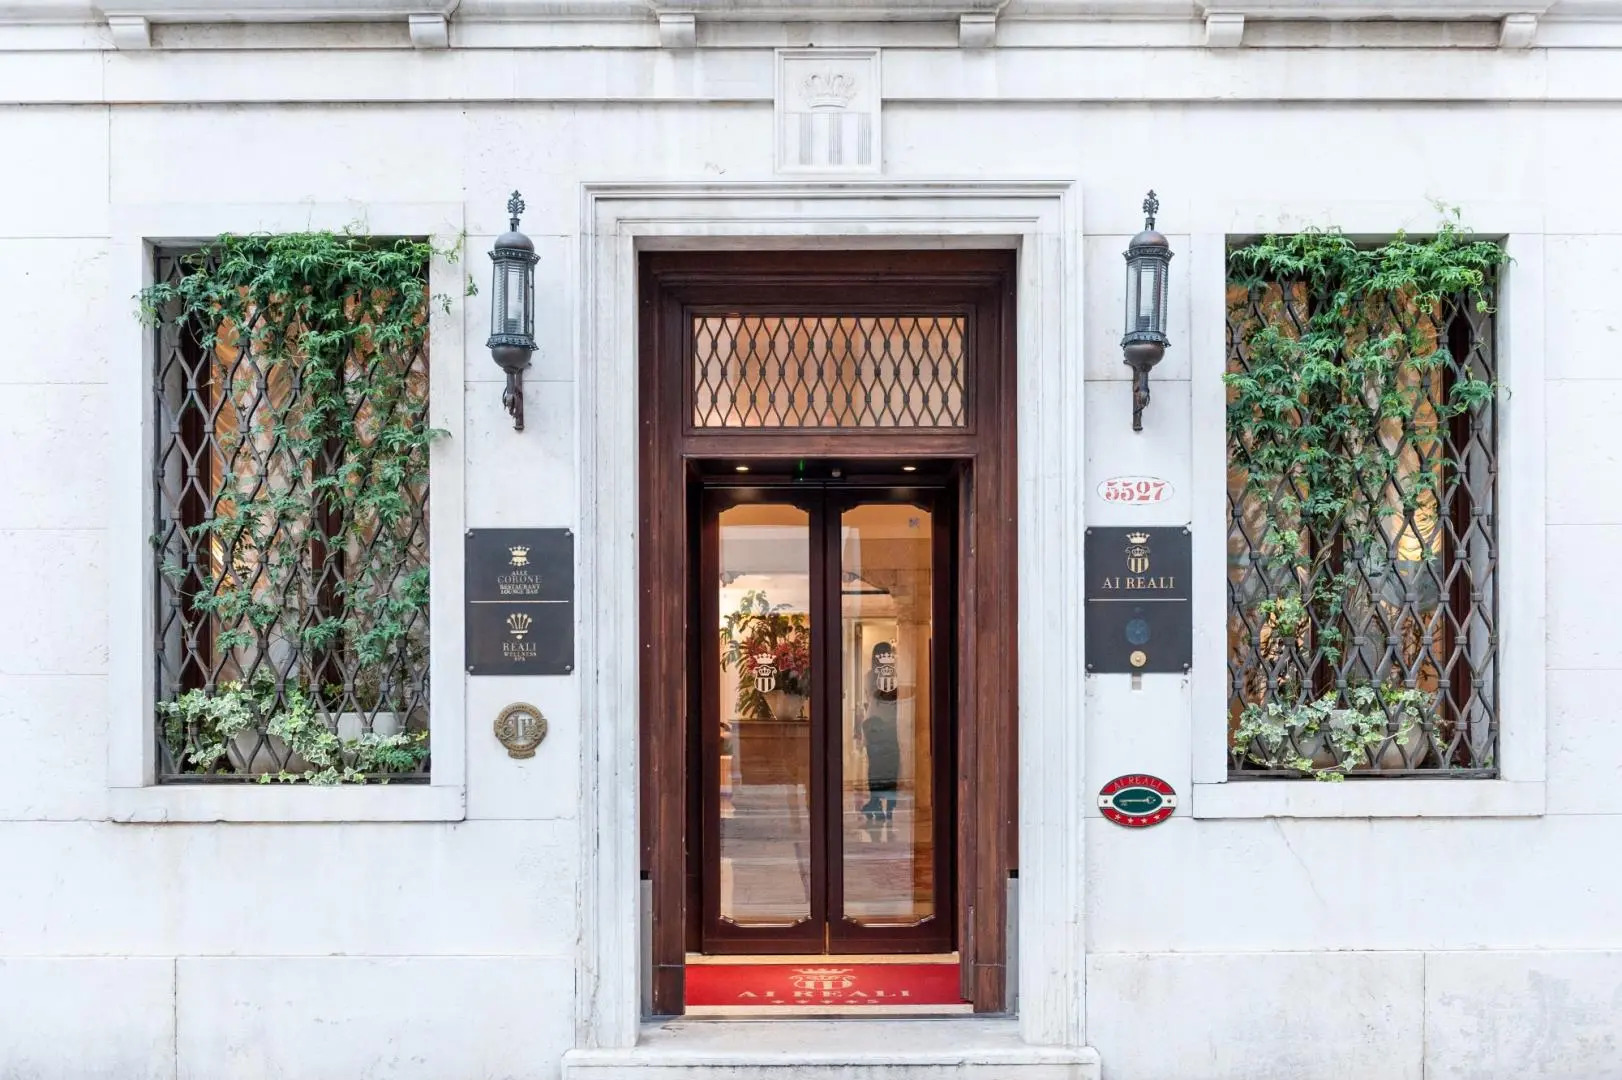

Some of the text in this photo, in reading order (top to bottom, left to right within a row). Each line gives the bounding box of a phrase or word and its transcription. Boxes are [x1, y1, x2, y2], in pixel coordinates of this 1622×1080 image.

[1105, 481, 1167, 501] 5527
[1102, 577, 1176, 589] AI REALI
[503, 642, 537, 651] REALI
[1113, 776, 1162, 792] AI REALI
[737, 990, 910, 998] AI REALI
